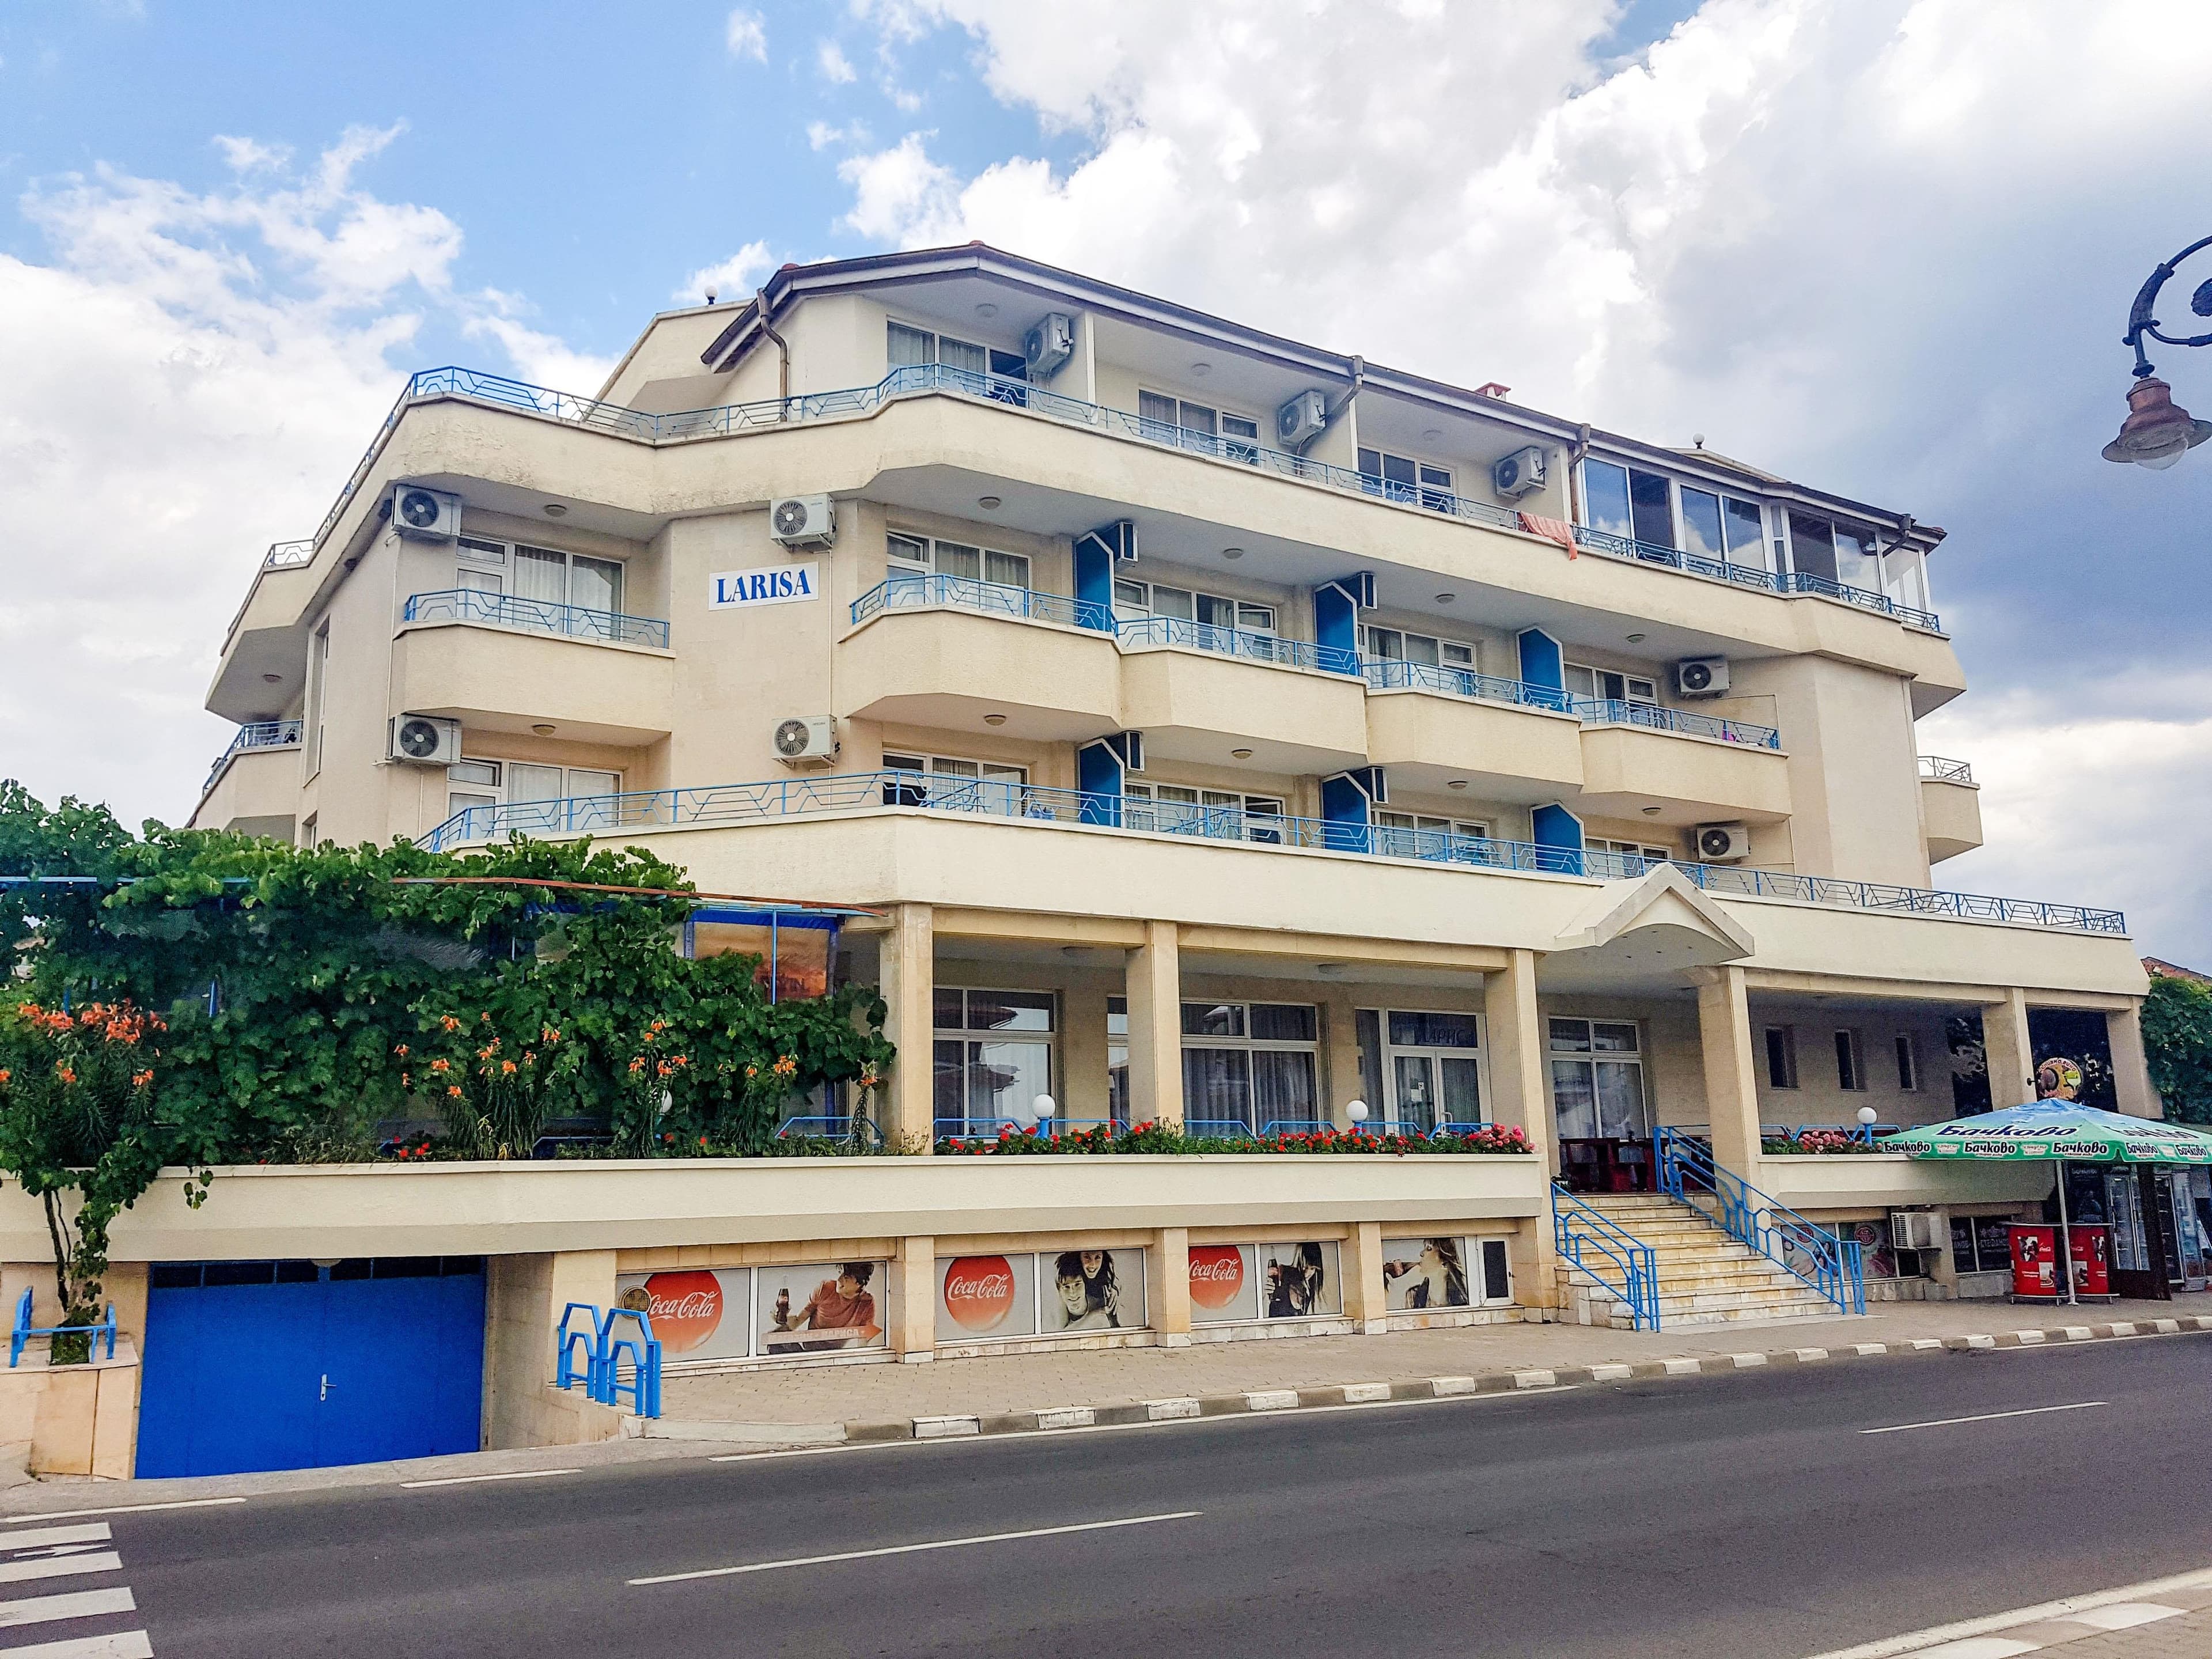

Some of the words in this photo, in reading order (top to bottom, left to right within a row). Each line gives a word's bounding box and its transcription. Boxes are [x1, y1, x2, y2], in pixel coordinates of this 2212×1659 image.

[716, 569, 812, 604] LARISA
[1936, 1125, 2077, 1137] Бачково
[1885, 1142, 1930, 1153] Бачково
[1965, 1142, 2015, 1154] Бачково
[2054, 1142, 2107, 1154] Бачково
[2126, 1142, 2158, 1154] Бачково
[2175, 1144, 2207, 1156] Бачково
[1189, 1259, 1240, 1282] Coca-Cola
[948, 1274, 1011, 1301] Coca-Cola
